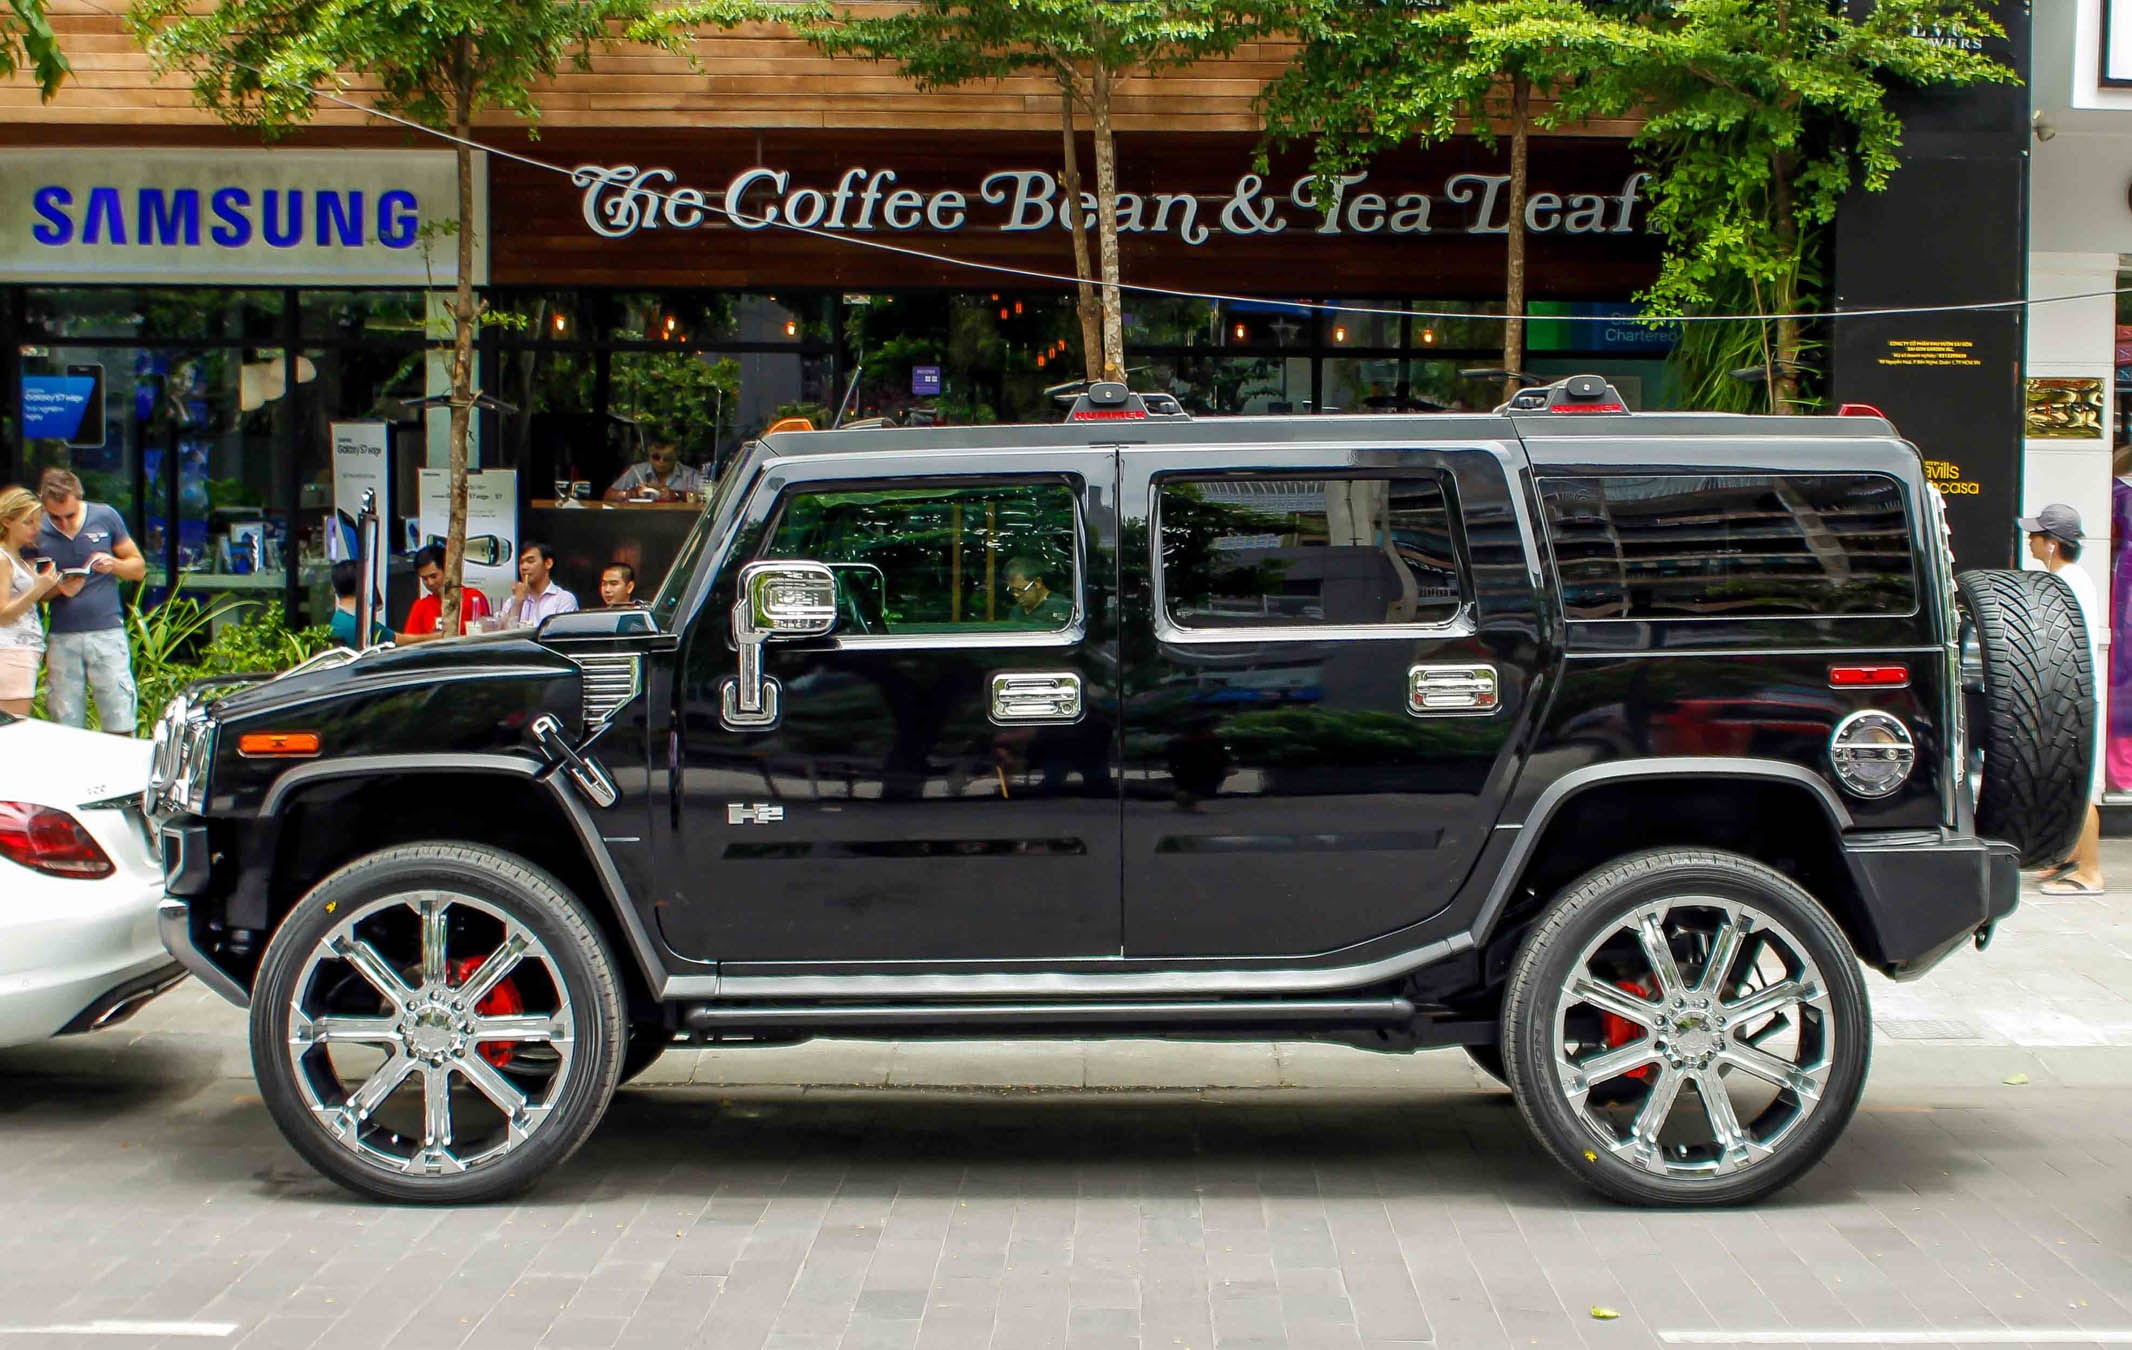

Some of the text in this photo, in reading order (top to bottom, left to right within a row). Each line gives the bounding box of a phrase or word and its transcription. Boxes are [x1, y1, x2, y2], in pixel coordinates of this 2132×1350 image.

[32, 186, 419, 249] SAMSUNG
[572, 164, 1652, 245] The Coffee Bean & Tea Leaf
